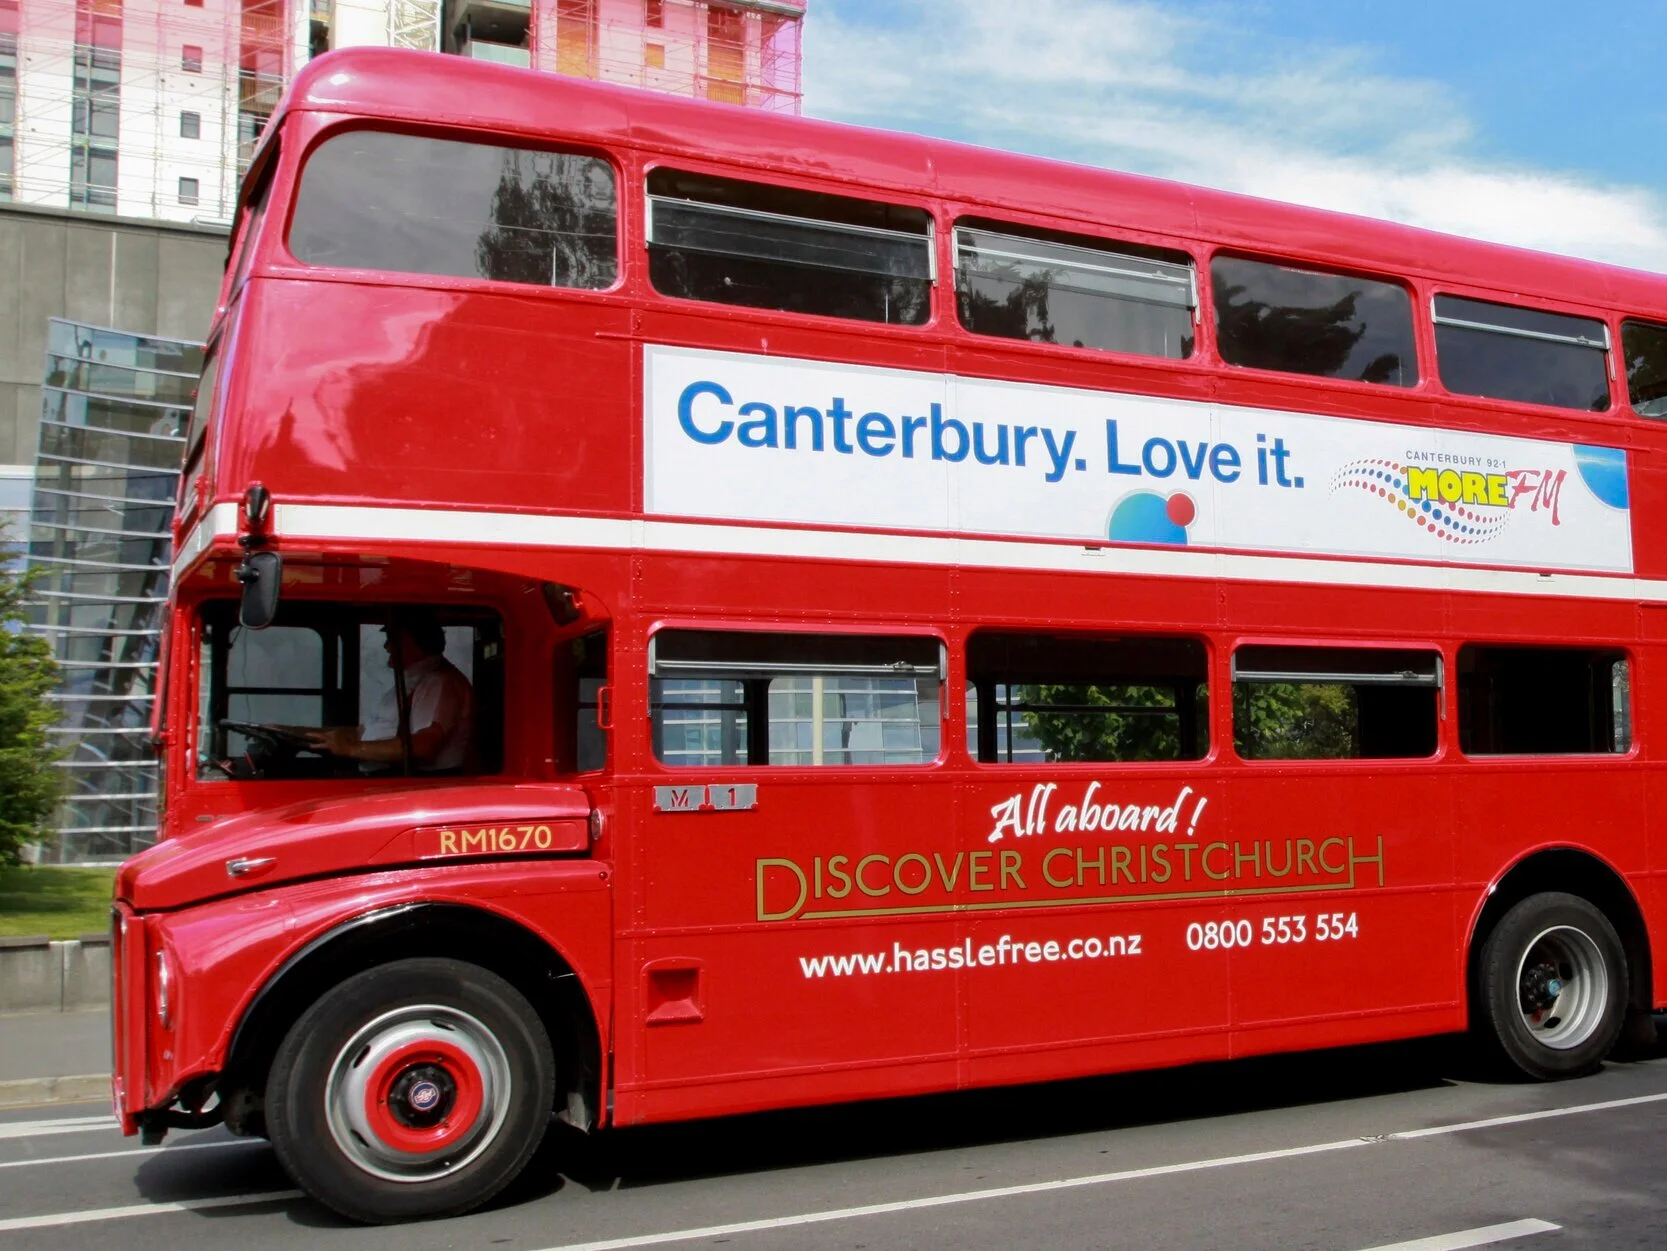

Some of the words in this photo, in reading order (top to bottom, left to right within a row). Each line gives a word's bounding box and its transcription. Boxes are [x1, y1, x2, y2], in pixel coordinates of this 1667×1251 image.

[677, 380, 1087, 483] Canterbury.
[1105, 418, 1242, 484] Love
[1256, 432, 1305, 489] it.
[1406, 450, 1482, 467] CANTERBURY
[1407, 466, 1510, 507] MORE
[1505, 469, 1568, 526] FM
[987, 782, 1058, 844] All
[439, 825, 553, 855] RM1670
[756, 849, 1028, 922] DISCOVER
[1042, 835, 1385, 889] CHRISTCHURCH
[798, 934, 1142, 979] www.hasslefree.co.nz
[1186, 919, 1253, 951] 0800
[1261, 914, 1307, 945] 553
[1315, 912, 1359, 942] 554
